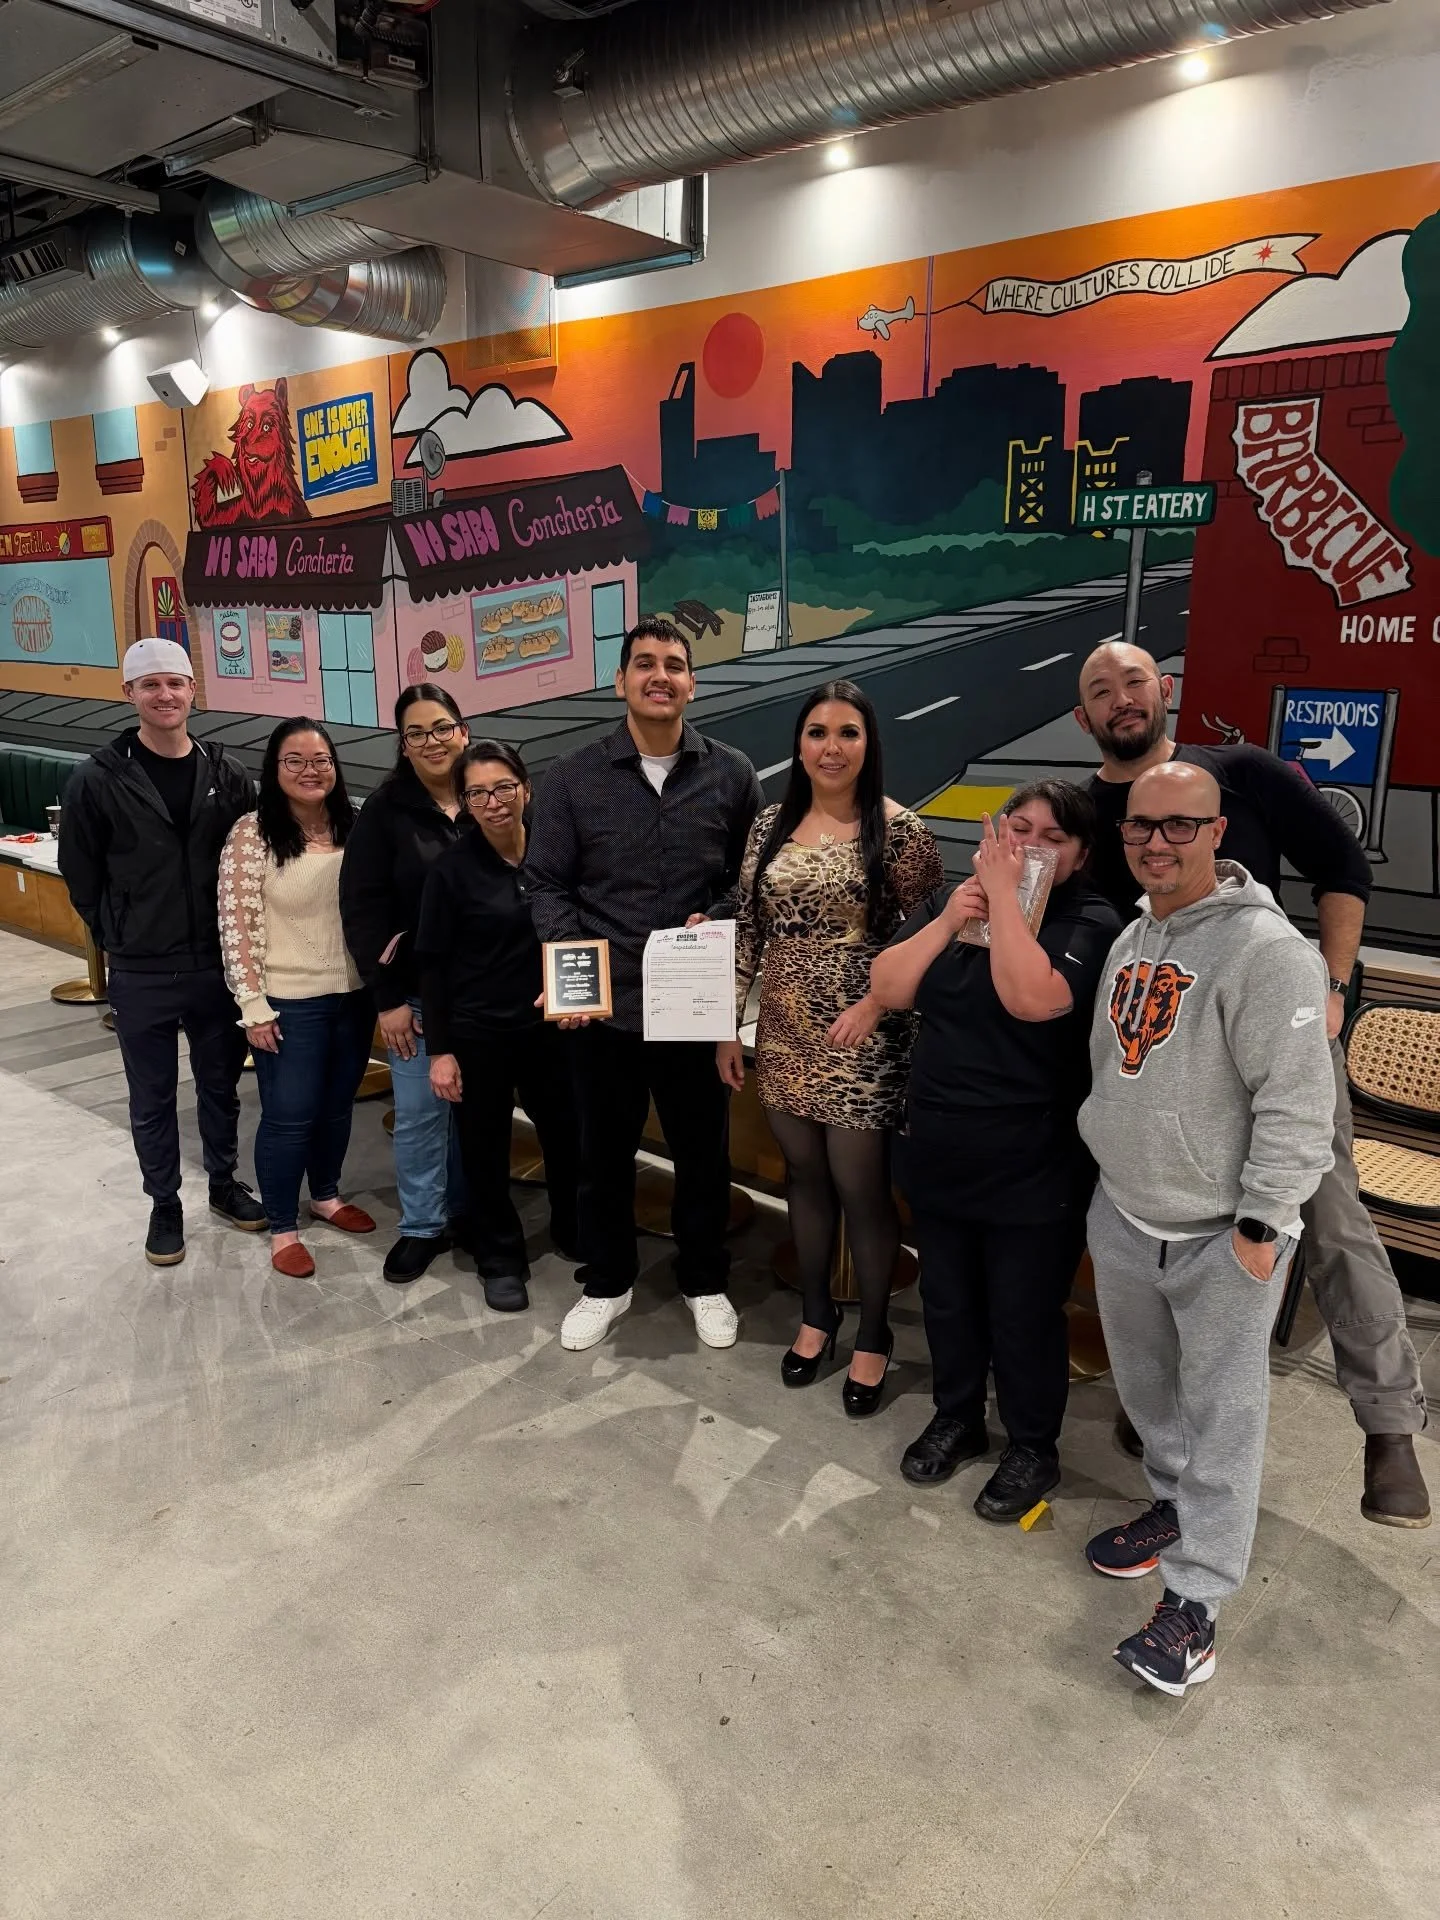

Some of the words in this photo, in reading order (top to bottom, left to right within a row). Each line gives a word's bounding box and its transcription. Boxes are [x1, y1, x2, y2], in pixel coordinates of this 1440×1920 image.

[991, 283, 1050, 311] WHERE
[1051, 262, 1141, 311] CULTURES
[1147, 250, 1235, 290] COLLIDE
[304, 409, 324, 439] ONE
[326, 405, 340, 434] IS
[339, 398, 369, 432] NEVER
[305, 425, 371, 483] ENOUGH
[1082, 495, 1096, 522] H
[1100, 495, 1130, 521] ST.
[1132, 492, 1208, 520] EATERY
[1242, 400, 1404, 605] BARBECUE
[14, 530, 53, 557] Tortilla
[404, 519, 447, 567] NO
[441, 505, 500, 561] SABO
[508, 495, 622, 547] Concheria
[204, 535, 232, 578] NO
[236, 535, 278, 579] SABO
[285, 536, 354, 576] Concheria
[1340, 615, 1416, 643] HOME
[1285, 700, 1379, 728] RESTROOMS
